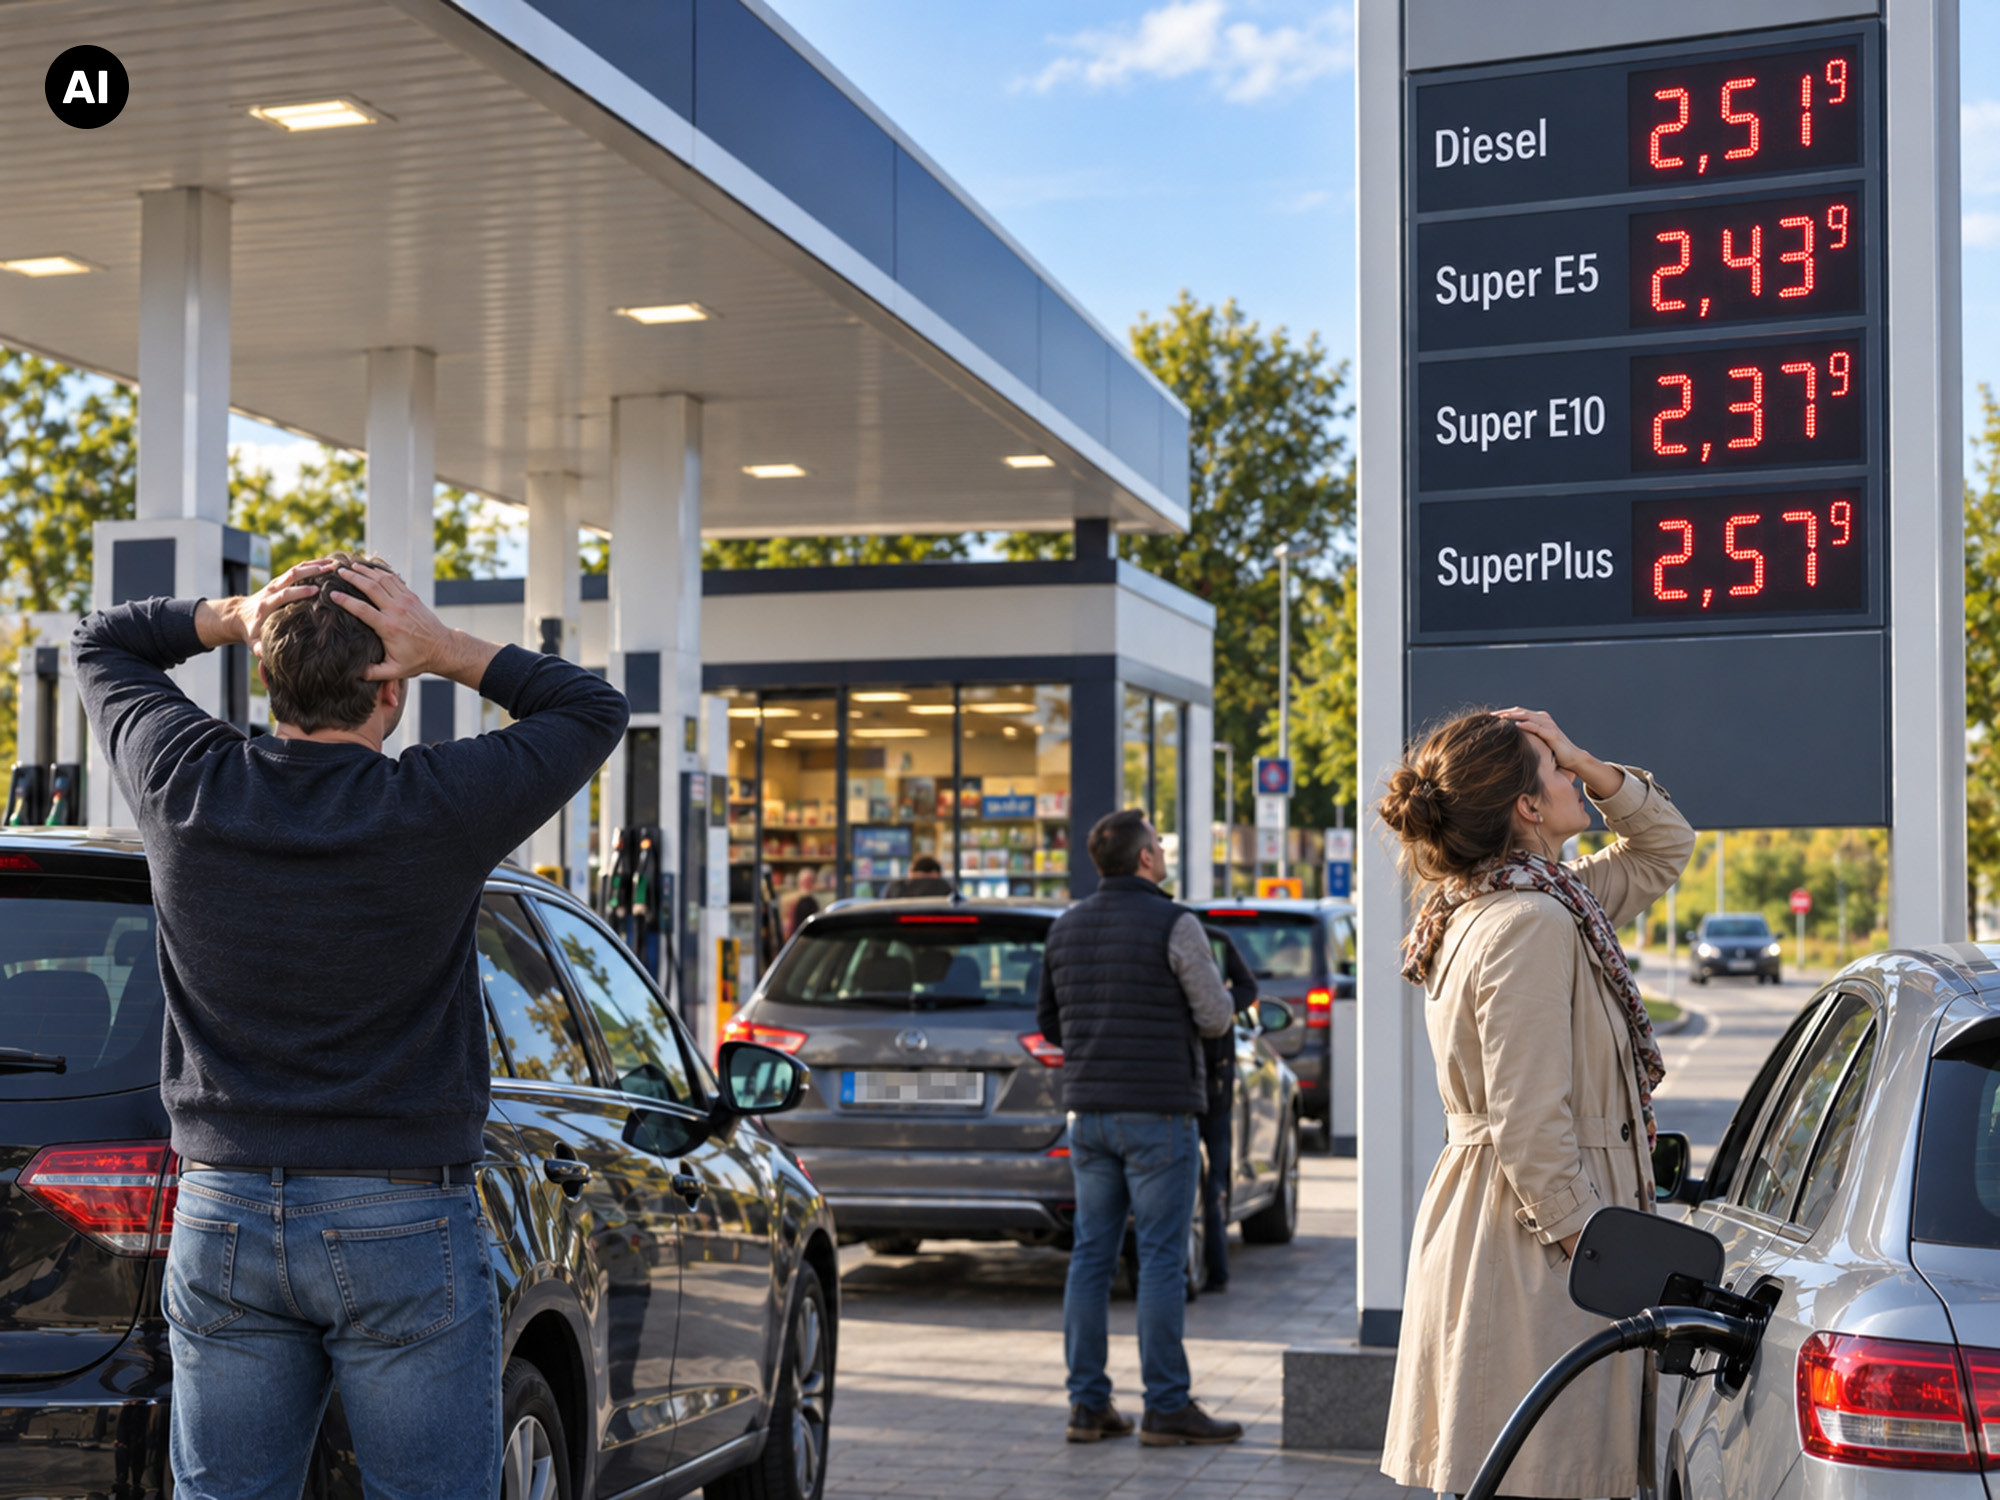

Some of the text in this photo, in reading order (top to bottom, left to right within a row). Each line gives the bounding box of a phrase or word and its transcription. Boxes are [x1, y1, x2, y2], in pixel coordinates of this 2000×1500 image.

[1435, 118, 1547, 168] Diesel
[1435, 266, 1542, 311] Super
[1554, 253, 1599, 295] E5
[1436, 405, 1538, 452] Super
[1549, 396, 1605, 438] E10
[1437, 541, 1614, 594] SuperPlus
